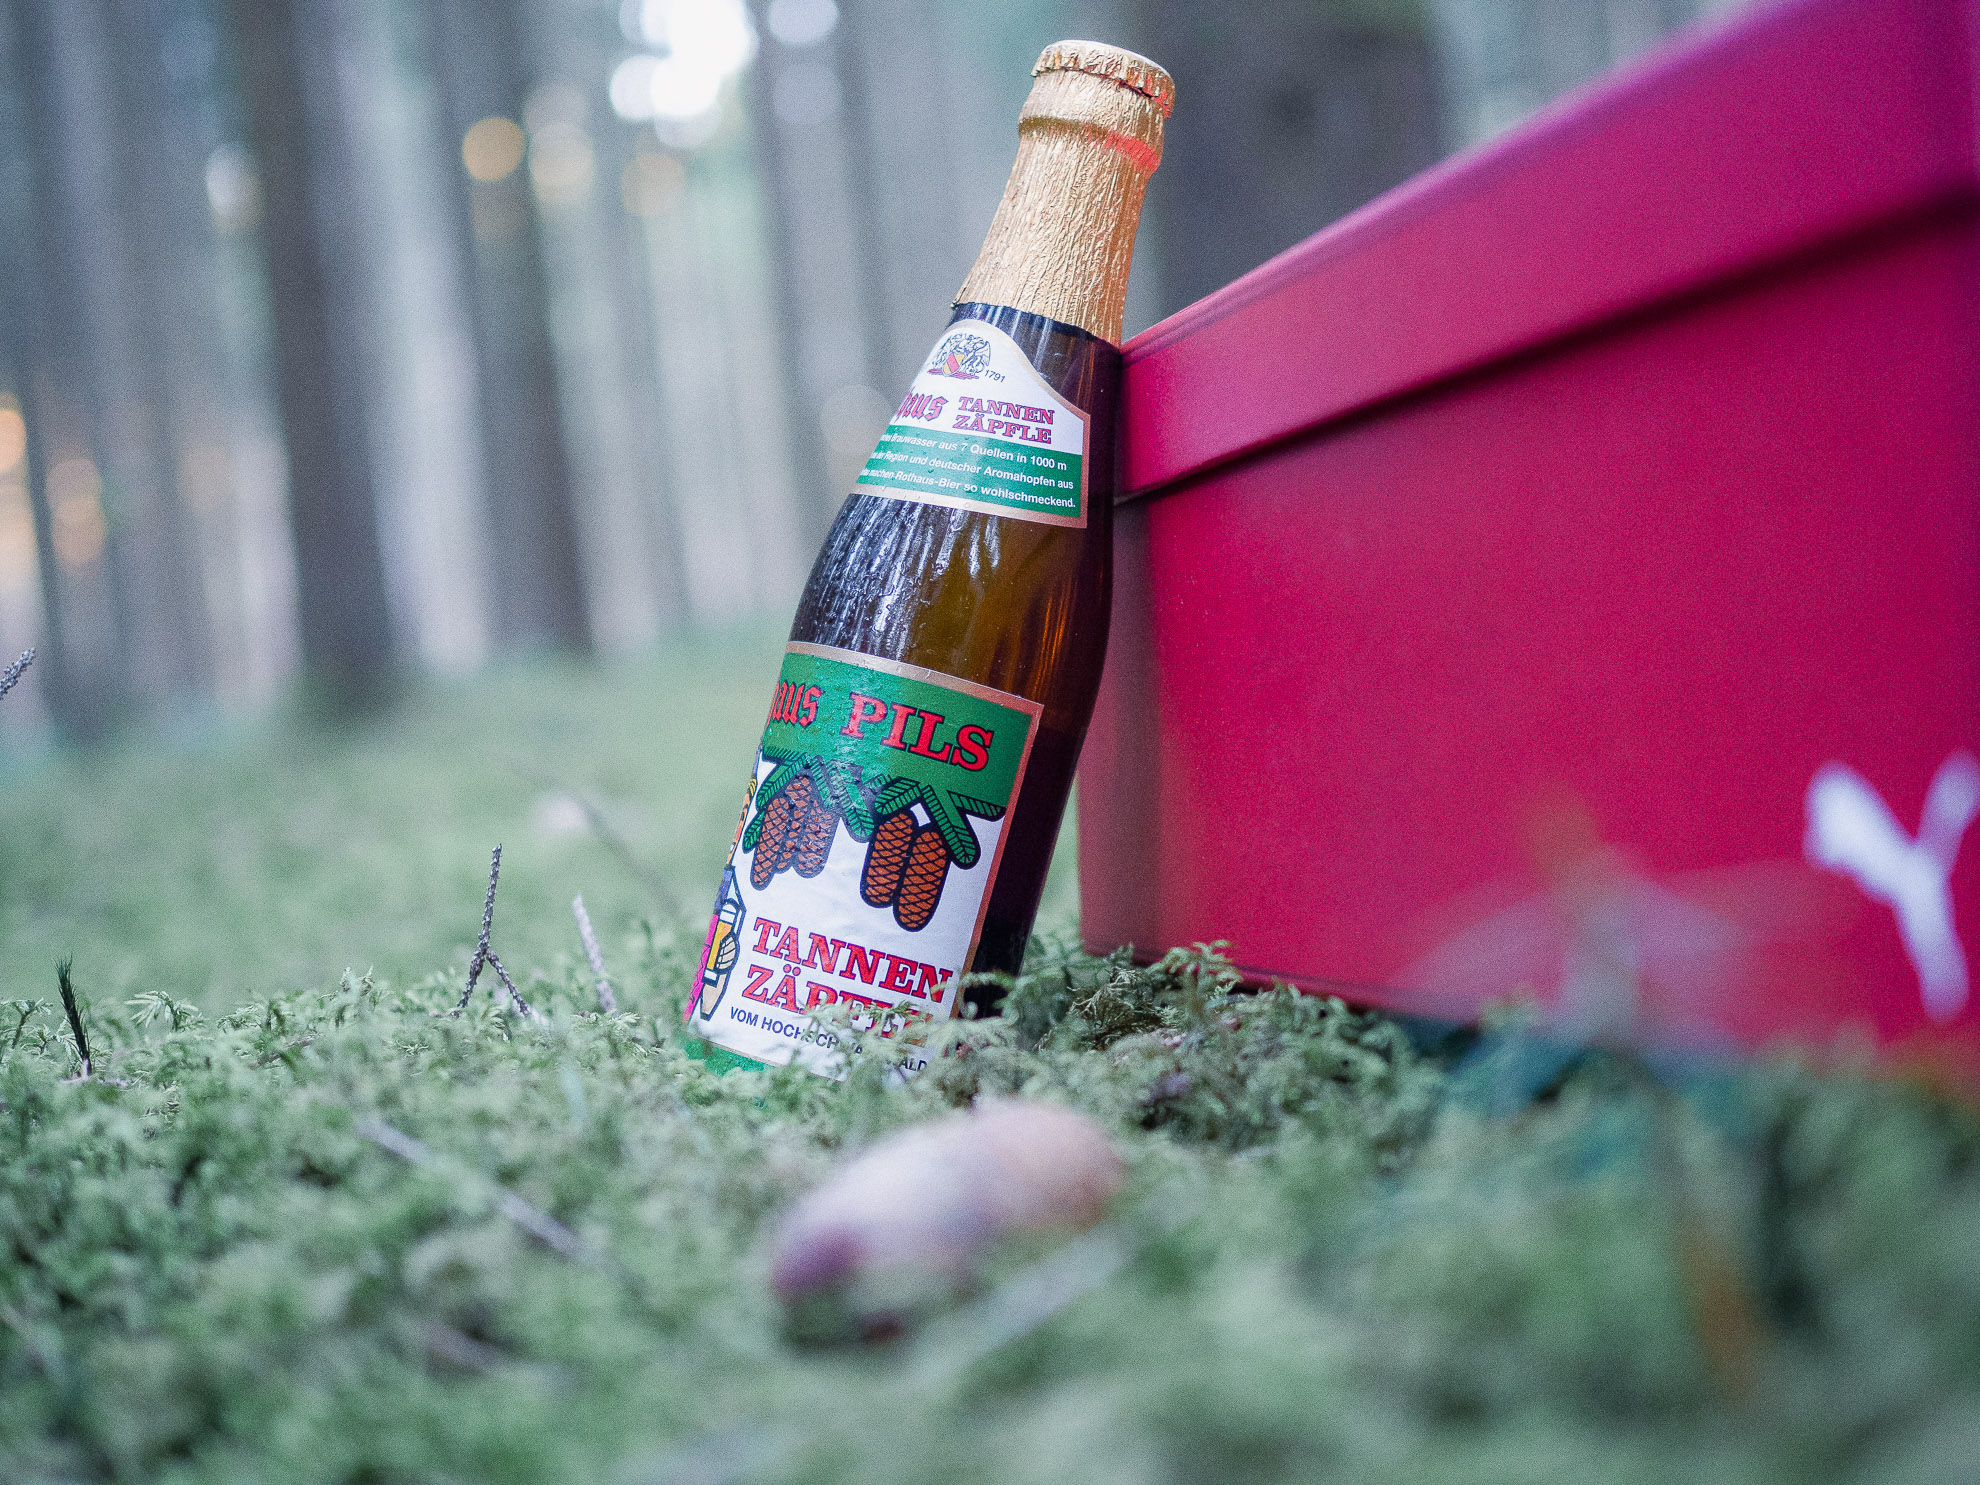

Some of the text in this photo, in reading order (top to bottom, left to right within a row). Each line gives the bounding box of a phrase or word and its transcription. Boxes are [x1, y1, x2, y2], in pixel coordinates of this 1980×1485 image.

[984, 369, 1006, 383] 1791
[952, 413, 1052, 444] ZÄPFLE
[958, 396, 1055, 425] TANNEN
[883, 450, 909, 463] Region
[909, 454, 929, 466] und
[928, 457, 982, 475] deutscher
[983, 466, 1056, 487] Aromahopfen
[1057, 480, 1075, 490] aus
[890, 433, 938, 449] Brauwasser
[938, 442, 958, 451] aus
[960, 442, 969, 452] 7
[970, 443, 1014, 461] Quellen
[1016, 452, 1028, 464] in
[1030, 455, 1056, 469] 1000
[1057, 461, 1068, 471] m
[894, 471, 962, 490] Rothaus-Bier
[963, 483, 978, 493] so
[980, 486, 1077, 509] wohlschmeckend.
[839, 692, 995, 772] PILS
[752, 916, 953, 1003] TANNEN
[730, 1006, 759, 1027] VOM
